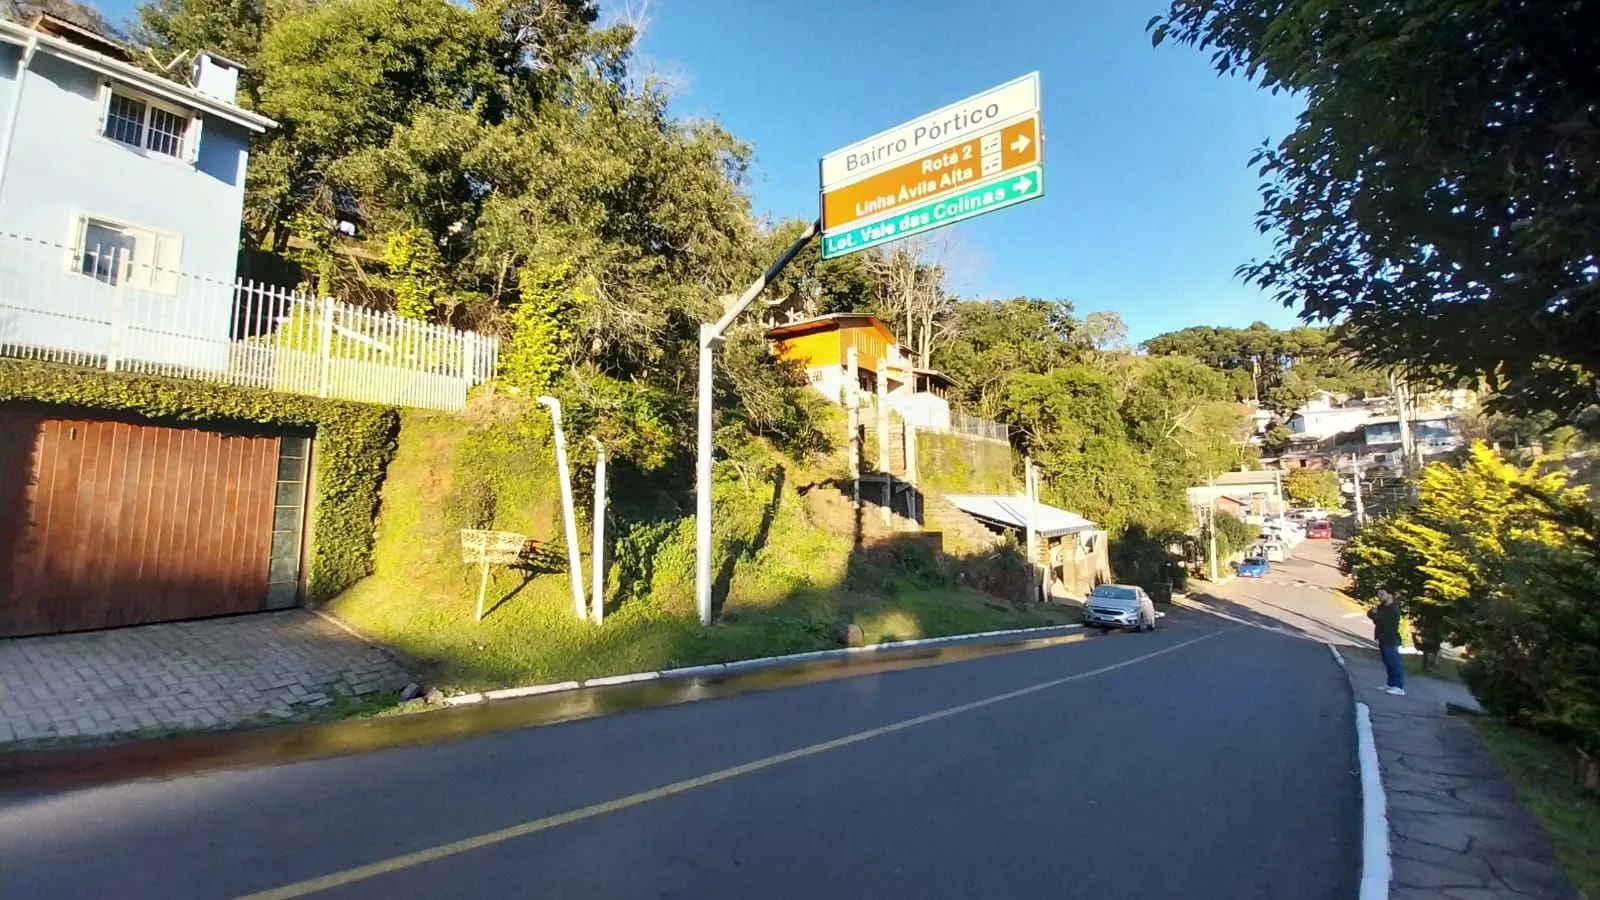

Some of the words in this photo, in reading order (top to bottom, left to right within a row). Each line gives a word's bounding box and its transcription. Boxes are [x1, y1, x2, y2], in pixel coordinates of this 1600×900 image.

[846, 138, 907, 171] Bairro
[914, 103, 999, 145] Pórtico
[921, 151, 958, 174] Rota
[962, 144, 973, 160] 2
[828, 235, 857, 252] Lot.
[860, 219, 896, 242] Vale
[899, 207, 930, 229] das
[933, 186, 1006, 219] Colinas
[855, 192, 896, 217] Linha
[898, 178, 936, 202] Ávila
[940, 165, 973, 188] Alta
